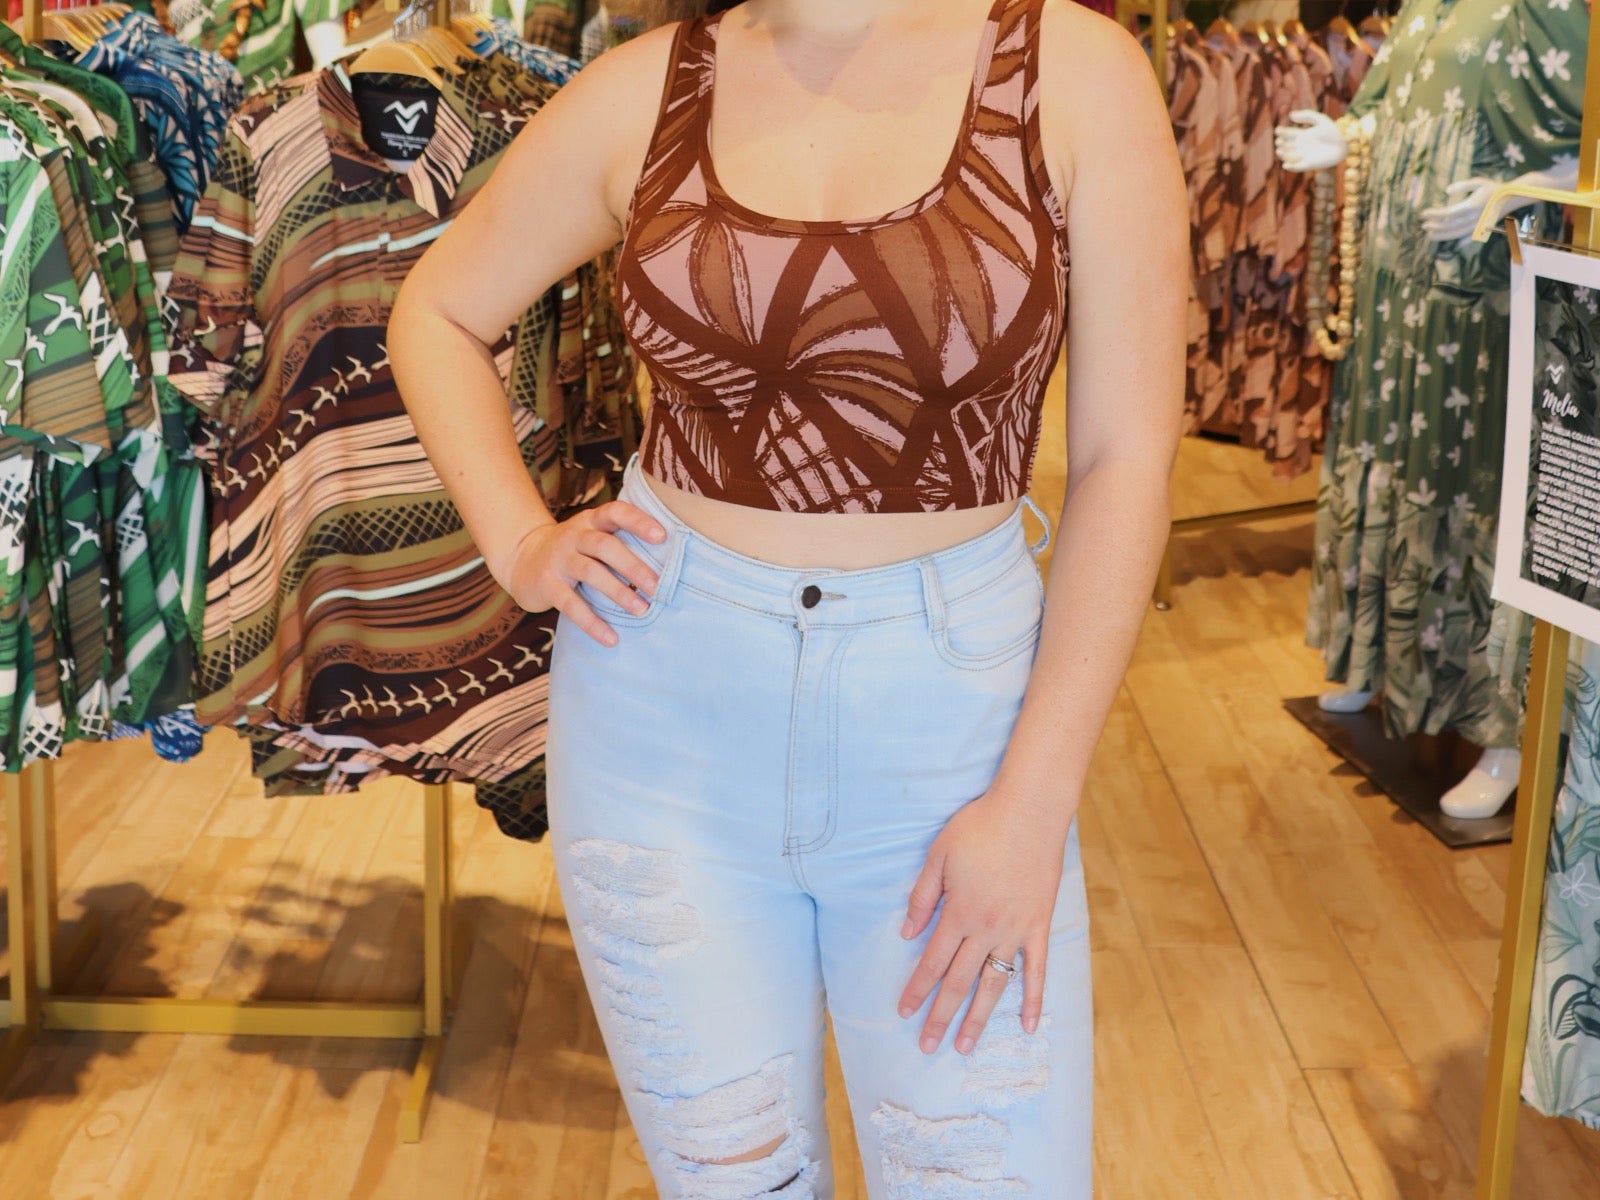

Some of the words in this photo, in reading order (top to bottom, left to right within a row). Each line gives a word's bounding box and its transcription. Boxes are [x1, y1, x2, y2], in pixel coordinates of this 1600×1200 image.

[1542, 389, 1579, 418] Melia
[1541, 443, 1576, 460] COLLECTION
[1562, 471, 1575, 481] AND
[1576, 507, 1589, 517] AND
